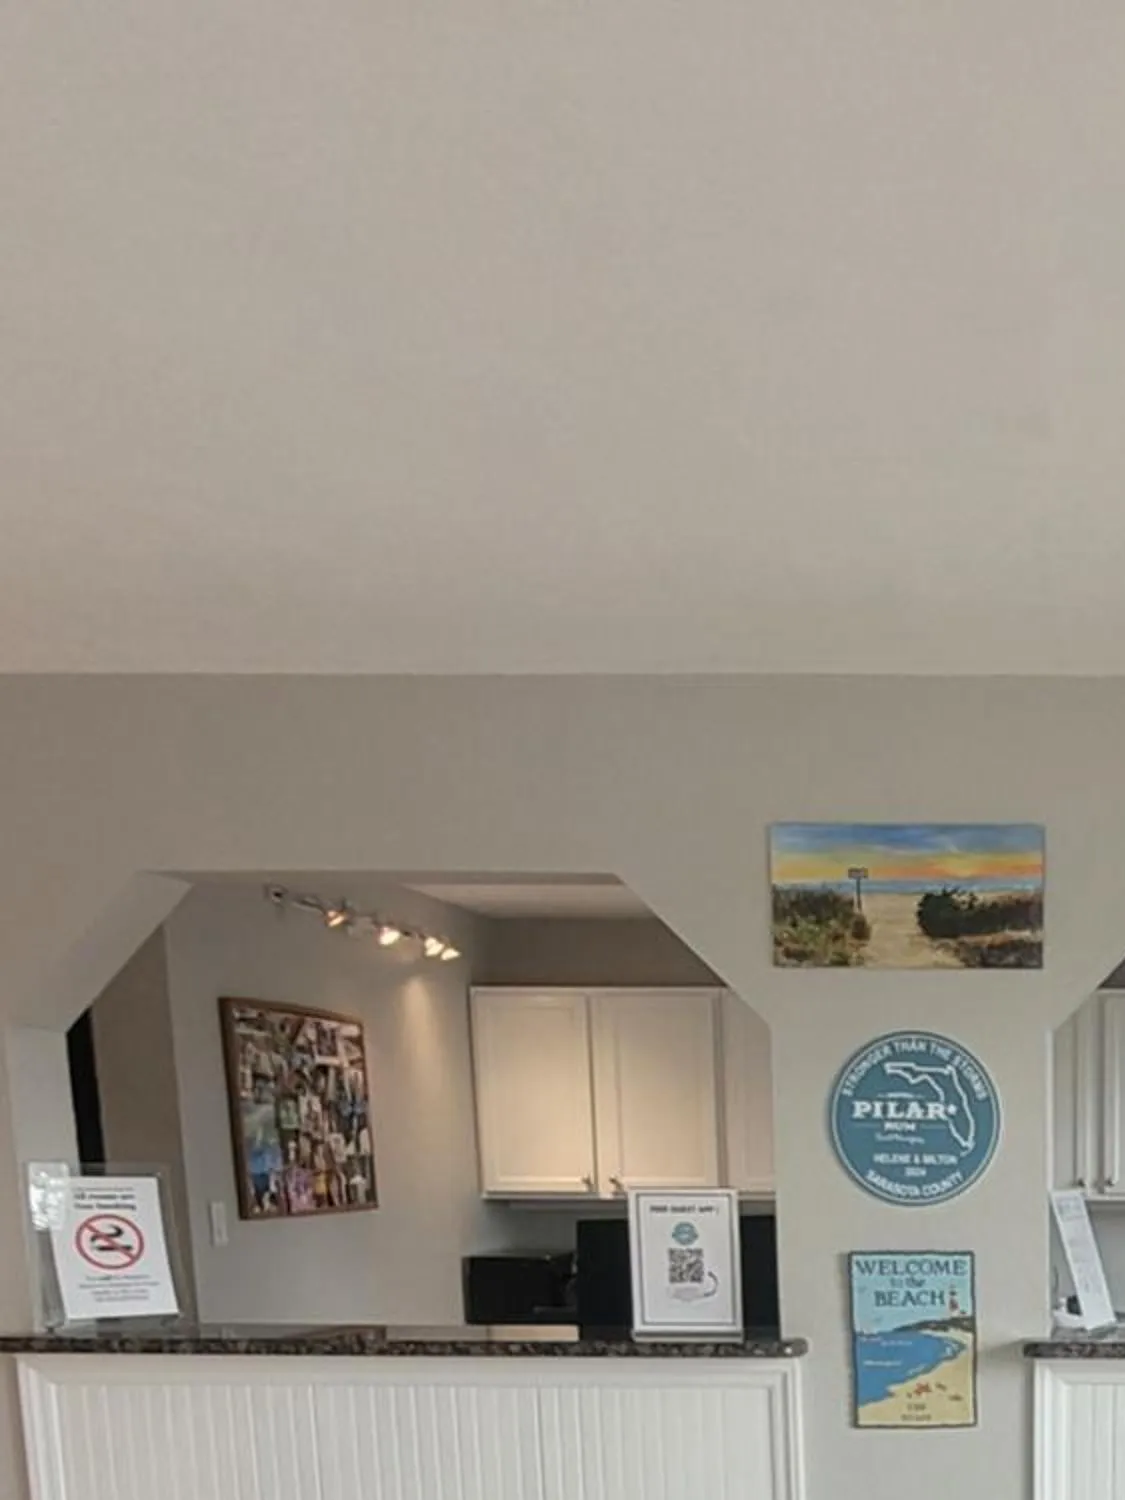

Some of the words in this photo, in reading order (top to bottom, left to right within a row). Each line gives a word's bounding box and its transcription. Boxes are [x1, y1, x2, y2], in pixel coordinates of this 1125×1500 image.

[893, 1039, 928, 1053] THAN
[929, 1041, 953, 1061] THE
[851, 1100, 950, 1120] PILAR
[922, 1170, 964, 1197] COUNTY
[855, 1258, 968, 1276] WELCOME
[906, 1276, 927, 1288] the
[874, 1290, 946, 1307] BEACH
